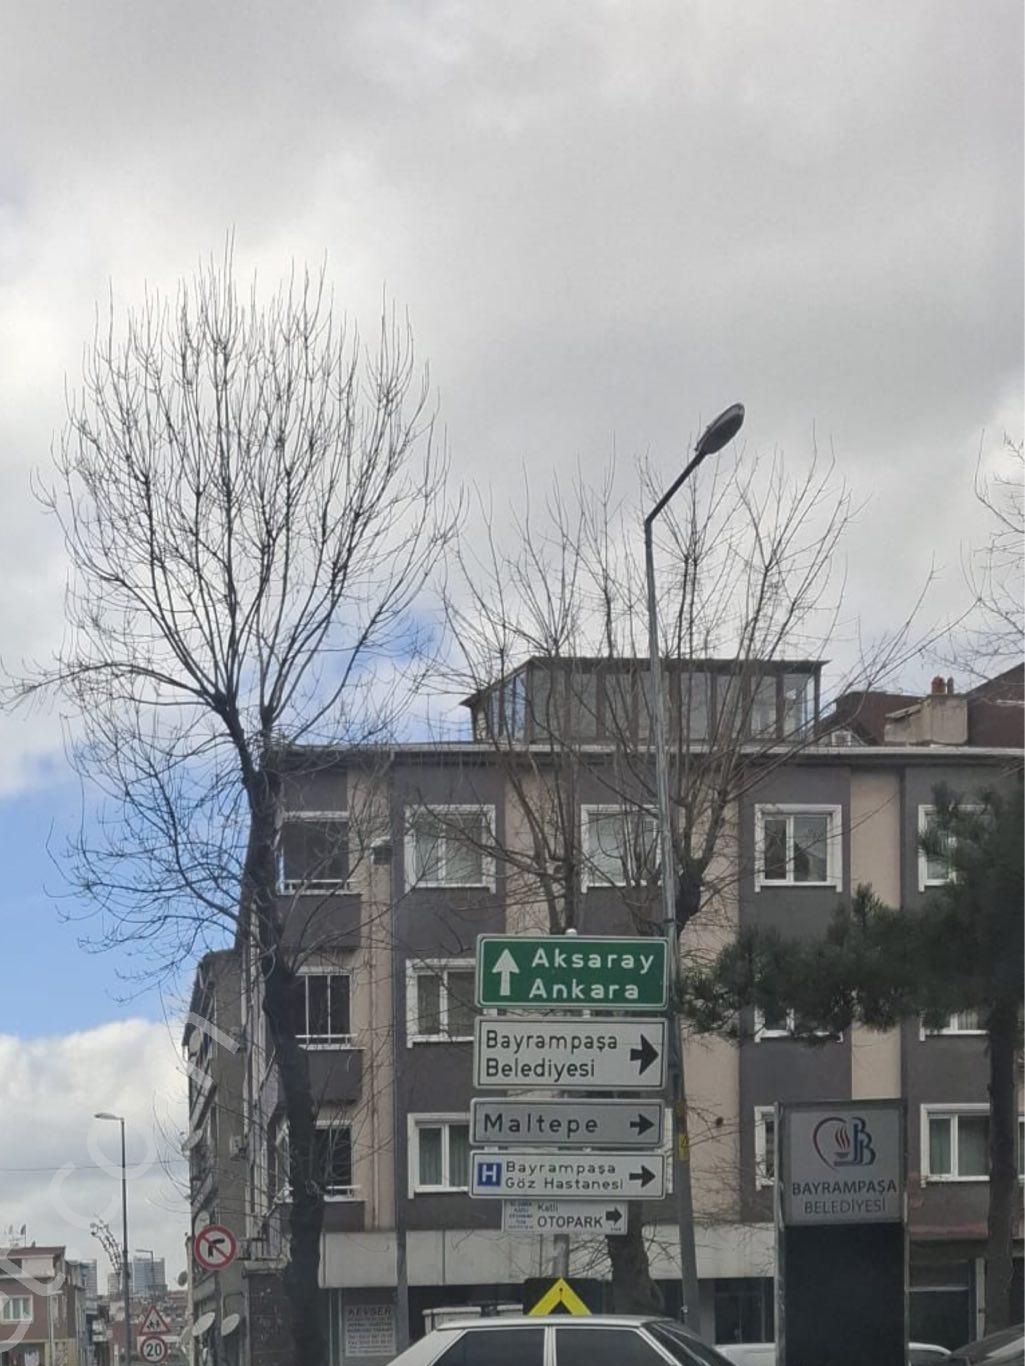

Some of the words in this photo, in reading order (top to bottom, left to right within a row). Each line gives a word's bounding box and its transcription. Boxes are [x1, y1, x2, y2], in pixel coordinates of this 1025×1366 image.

[531, 947, 654, 974] Aksaray
[529, 978, 639, 999] Ankara
[486, 1029, 618, 1055] Bayrampaşa
[486, 1057, 595, 1083] Belediyesi
[484, 1112, 598, 1139] Maltepe
[505, 1160, 616, 1176] Bayrampaşa
[505, 1177, 536, 1190] Göz
[544, 1178, 624, 1191] Hastanesi
[792, 1179, 897, 1196] BAYRAMPAŞA
[804, 1197, 886, 1215] BELEDİYESİ
[537, 1215, 603, 1229] OTOPARK
[146, 1343, 162, 1358] 20
